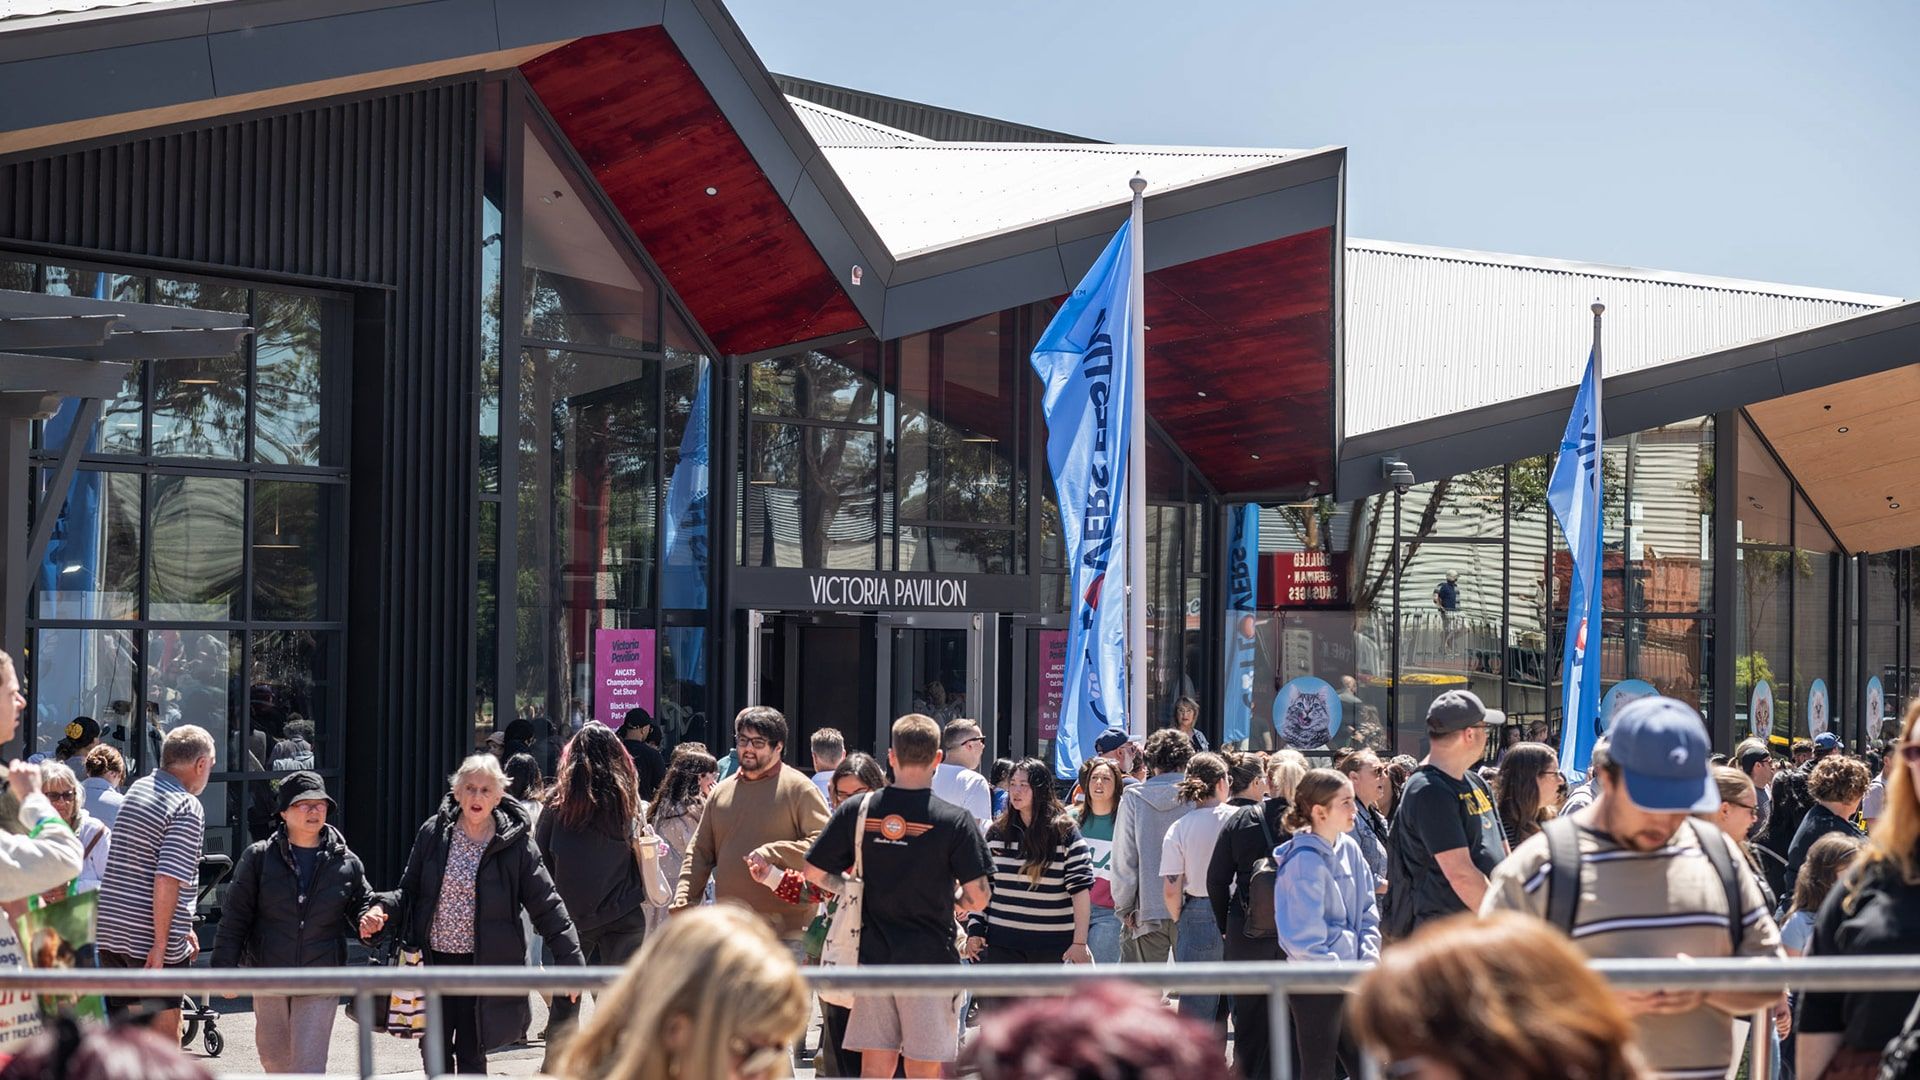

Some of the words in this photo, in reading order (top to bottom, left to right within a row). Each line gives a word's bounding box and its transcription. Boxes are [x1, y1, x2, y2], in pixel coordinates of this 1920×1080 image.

[810, 576, 889, 606] VICTORIA
[895, 579, 967, 607] PAVILION
[612, 640, 639, 651] Victoria
[611, 650, 640, 663] Pavilion
[606, 677, 644, 687] Championship
